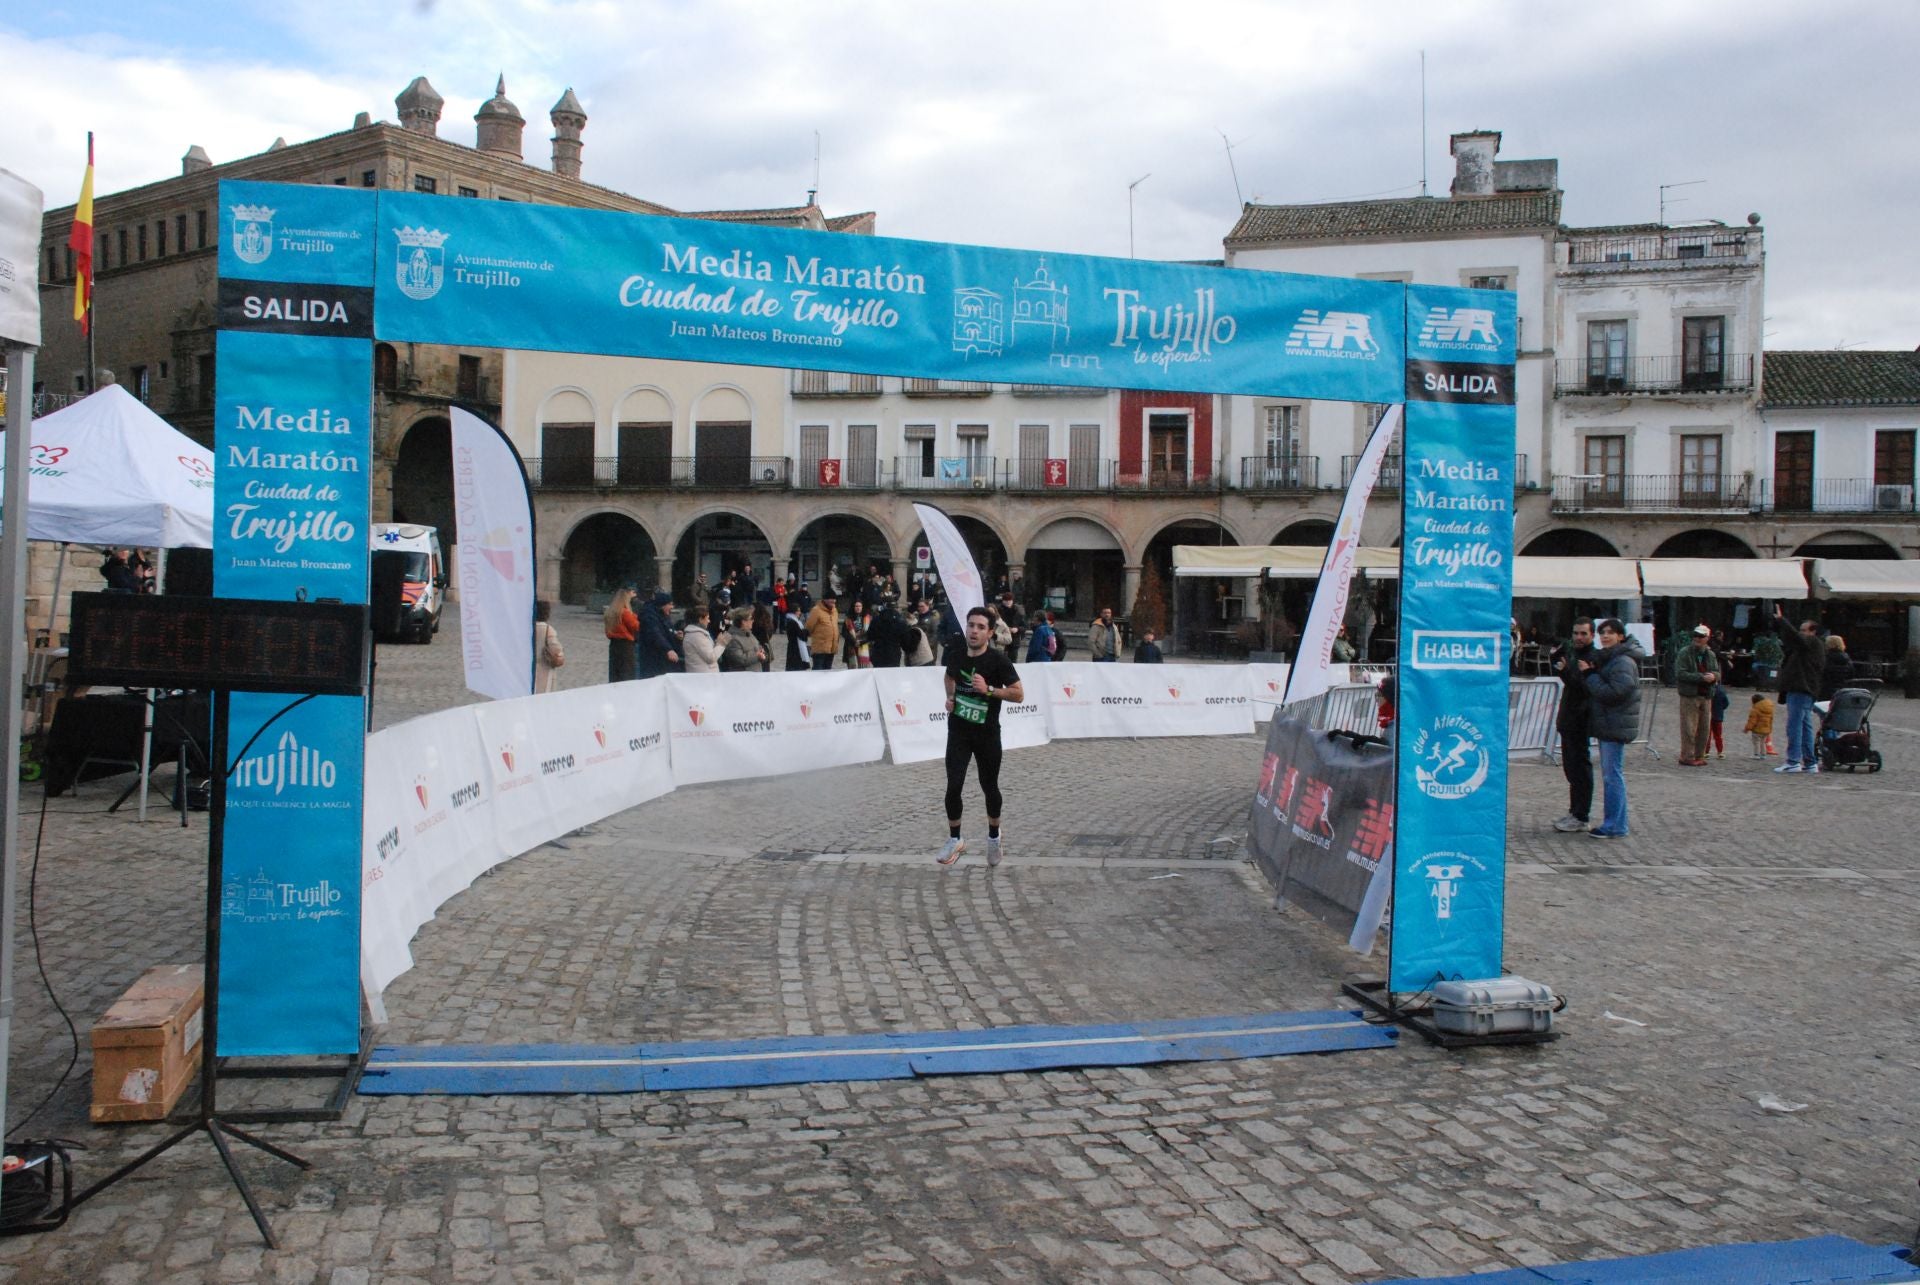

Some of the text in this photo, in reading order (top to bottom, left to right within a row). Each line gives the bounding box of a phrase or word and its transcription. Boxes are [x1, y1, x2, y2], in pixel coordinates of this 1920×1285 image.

[281, 226, 362, 240] Ayuntamiento de
[280, 238, 334, 255] Trujillo
[455, 253, 554, 271] Ayuntamiento de
[661, 242, 926, 295] Media Maratón
[453, 268, 521, 290] Trujillo
[244, 296, 349, 323] SALIDA
[619, 275, 899, 335] Ciudad de Trujillo
[1103, 287, 1237, 356] Trujillo
[669, 321, 842, 347] Juan Mateos Broncano
[1133, 342, 1148, 364] te
[1285, 347, 1376, 361] www.musicrun.es
[1418, 340, 1498, 352] www.musicrun.es
[1424, 372, 1498, 394] SALIDA
[236, 405, 351, 434] Media
[227, 445, 360, 472] Maratón
[1420, 459, 1500, 481] Media
[244, 480, 341, 501] Ciudad de
[1414, 490, 1506, 511] Maratón
[226, 503, 355, 553] Trujillo
[1424, 518, 1490, 535] Ciudad de
[232, 557, 351, 570] Juan Mateos Broncano
[1412, 536, 1503, 576] Trujillo
[1424, 643, 1487, 659] HABLA
[959, 705, 980, 721] 218
[1412, 714, 1484, 755] Club Atletismo
[235, 730, 336, 795] trujillo
[1420, 779, 1472, 795] TRUJILLO
[277, 880, 341, 907] Trujillo
[1431, 883, 1457, 897] A J
[1440, 897, 1448, 911] S
